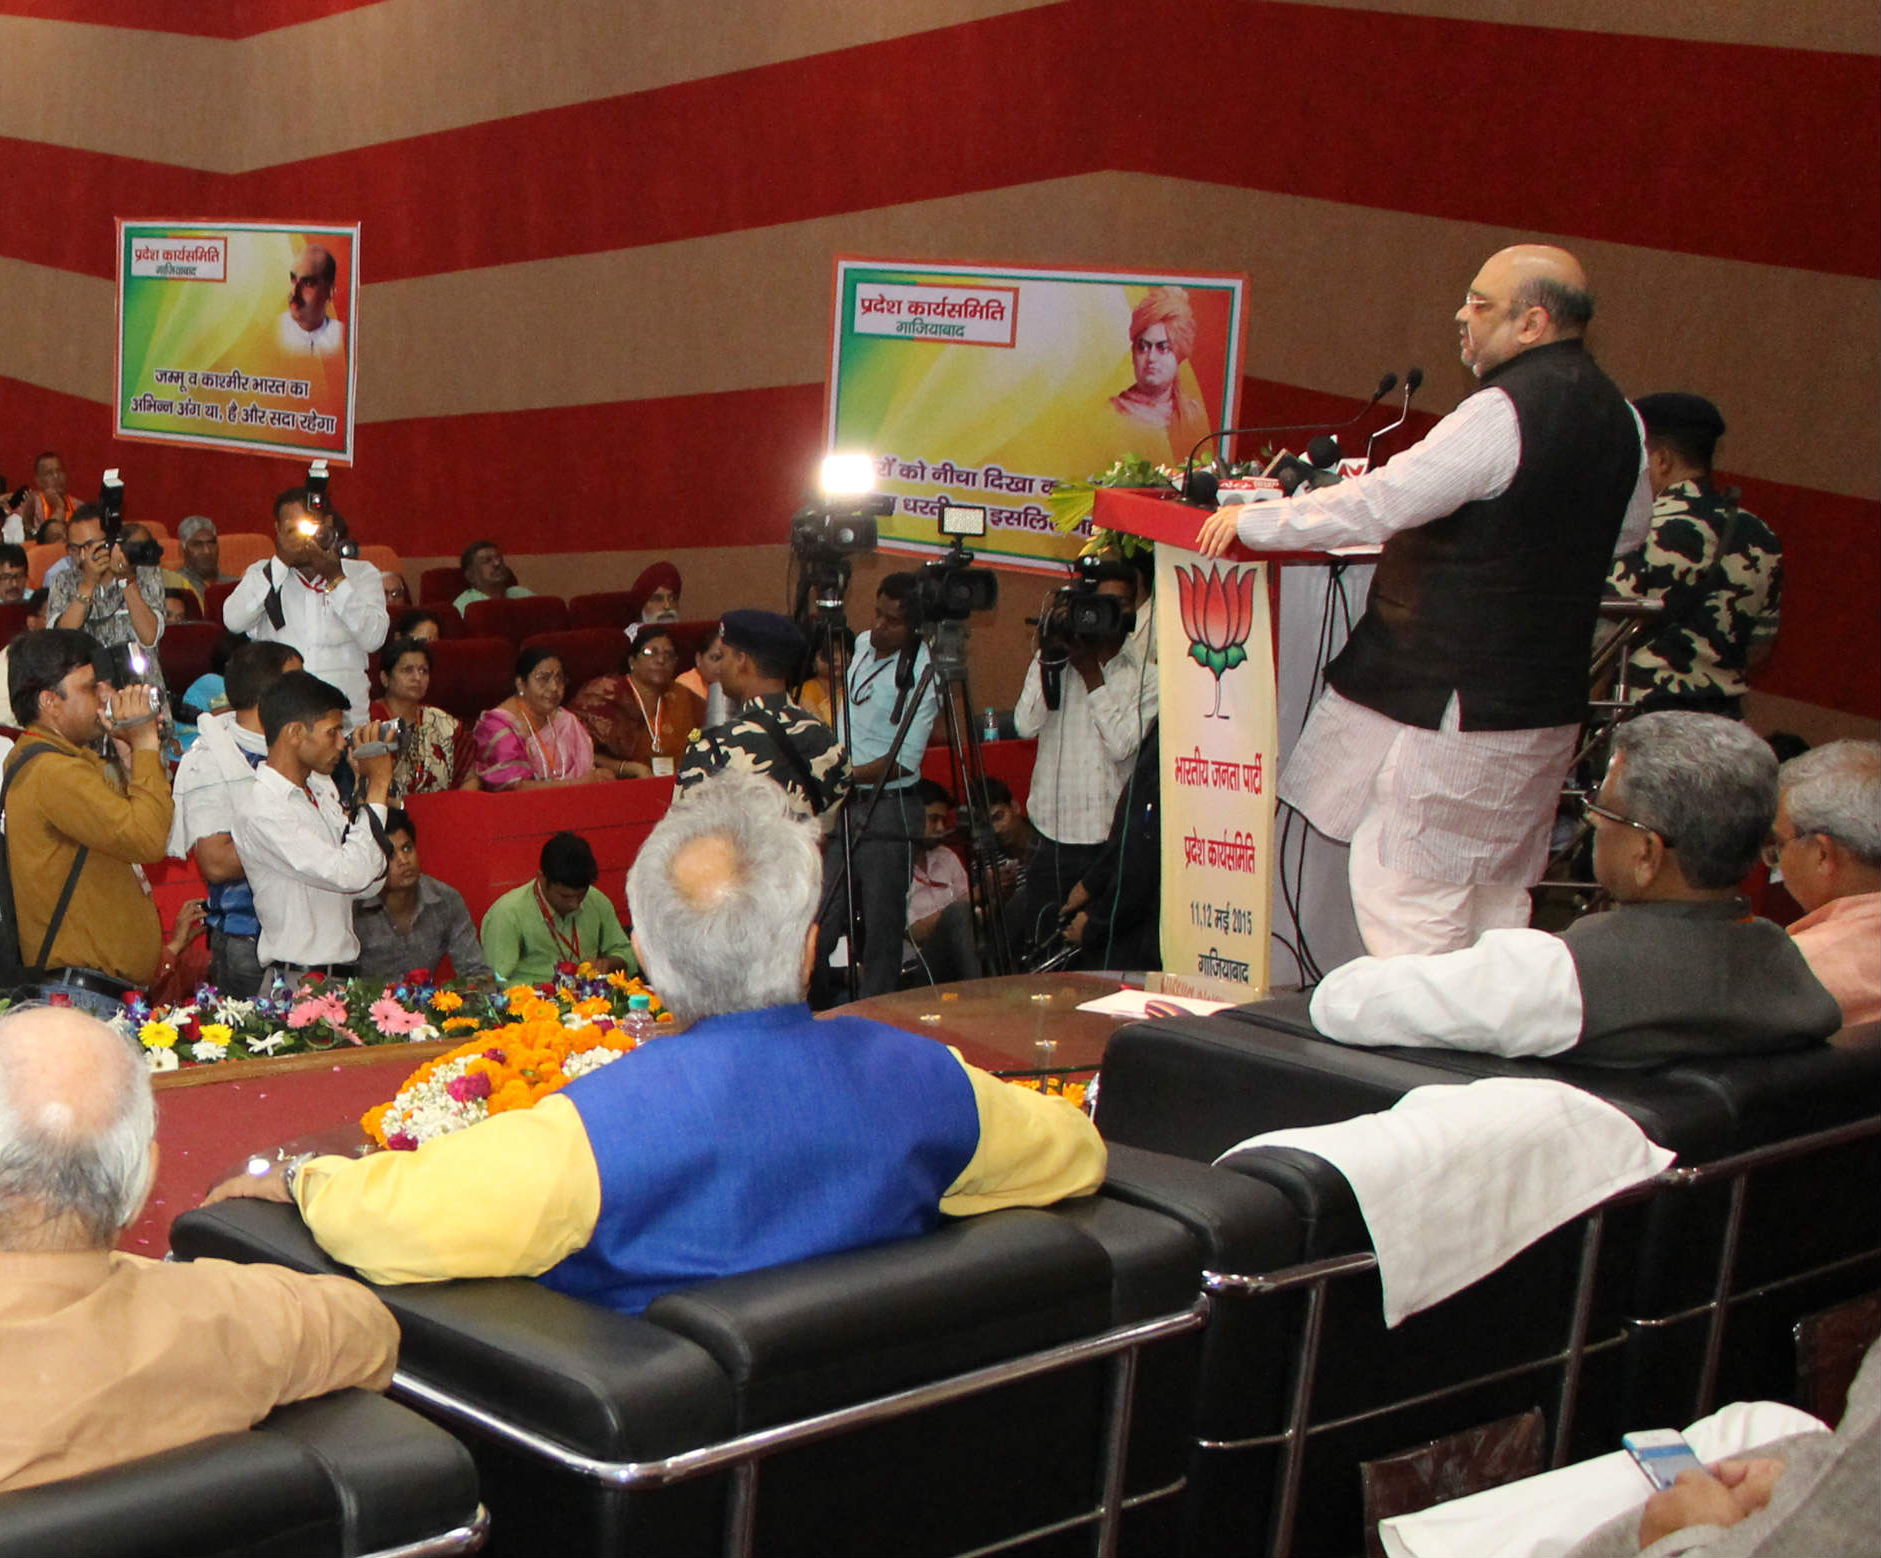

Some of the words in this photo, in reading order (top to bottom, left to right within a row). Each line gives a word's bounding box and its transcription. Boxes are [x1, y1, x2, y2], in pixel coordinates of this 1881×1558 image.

[135, 245, 159, 263] प्रदेश
[162, 245, 220, 262] कार्यसमिति
[861, 293, 903, 316] प्रदेश
[908, 296, 1006, 321] कार्यसमिति
[896, 317, 966, 337] गाजियाबाद
[155, 369, 187, 393] जम्मू
[189, 371, 198, 386] व
[201, 370, 249, 391] काश्मीर
[252, 378, 286, 394] भारत
[290, 381, 308, 397] का
[131, 393, 174, 414] अभिन्न
[177, 398, 200, 417] अंग
[228, 402, 238, 422] है
[241, 405, 266, 424] और
[269, 411, 295, 428] सदा
[300, 411, 335, 433] रहेगा
[898, 462, 926, 481] को
[932, 462, 978, 487] नीचा
[984, 467, 1036, 494] दिखा
[1175, 746, 1208, 787] भारतीय
[1211, 760, 1240, 791] जनता
[1243, 752, 1262, 794] पार्टी
[1184, 827, 1205, 870] प्रदेश
[1208, 829, 1255, 874] कार्यसमिति
[1214, 902, 1230, 936] मई
[1232, 908, 1252, 936] 2015
[1198, 947, 1249, 984] गाजियाबाद
